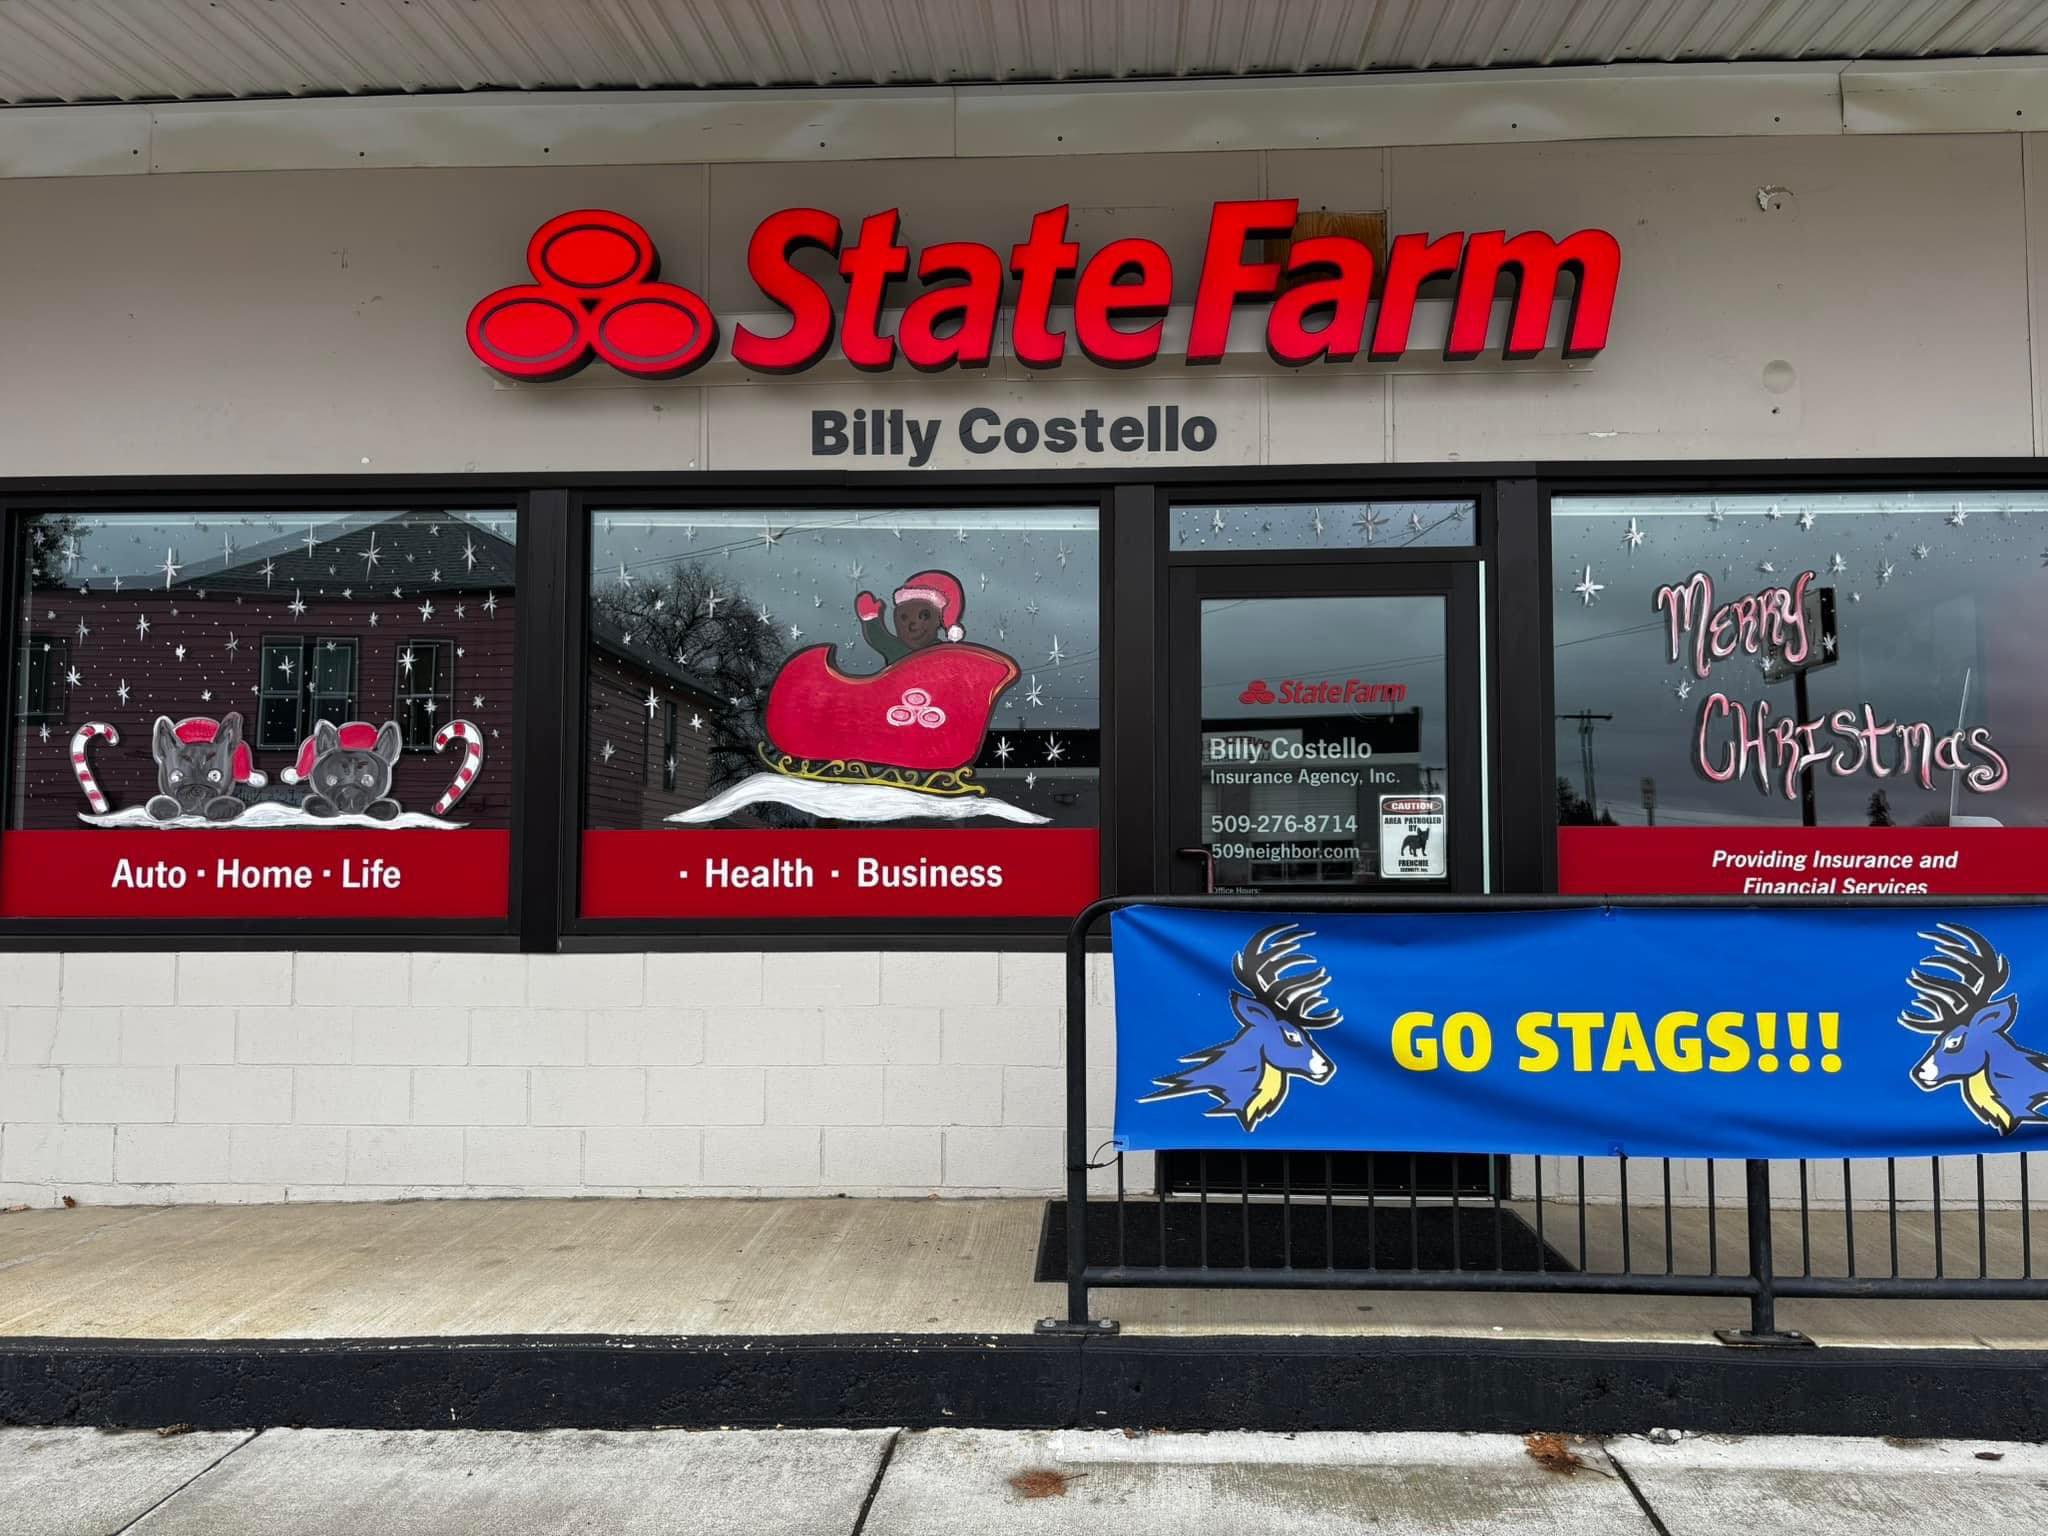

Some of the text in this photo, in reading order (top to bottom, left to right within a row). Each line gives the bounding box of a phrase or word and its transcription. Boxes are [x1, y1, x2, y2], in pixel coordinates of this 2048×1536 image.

[811, 406, 1217, 467] Billy Costello
[1210, 737, 1262, 764] Billy
[1271, 737, 1372, 759] Costello
[1210, 768, 1401, 787] Insurance Agency, Inc.
[1391, 802, 1433, 810] CAUTION
[1211, 814, 1359, 833] 509-276-8714
[1211, 843, 1360, 862] 509neighbor.com
[1712, 850, 1959, 872] Providing Insurance and
[112, 858, 401, 889] Auto Home Life
[704, 857, 1003, 888] Health Business
[1743, 877, 1929, 894] Financial Services
[1391, 1011, 1842, 1073] GO STAGS!!!
